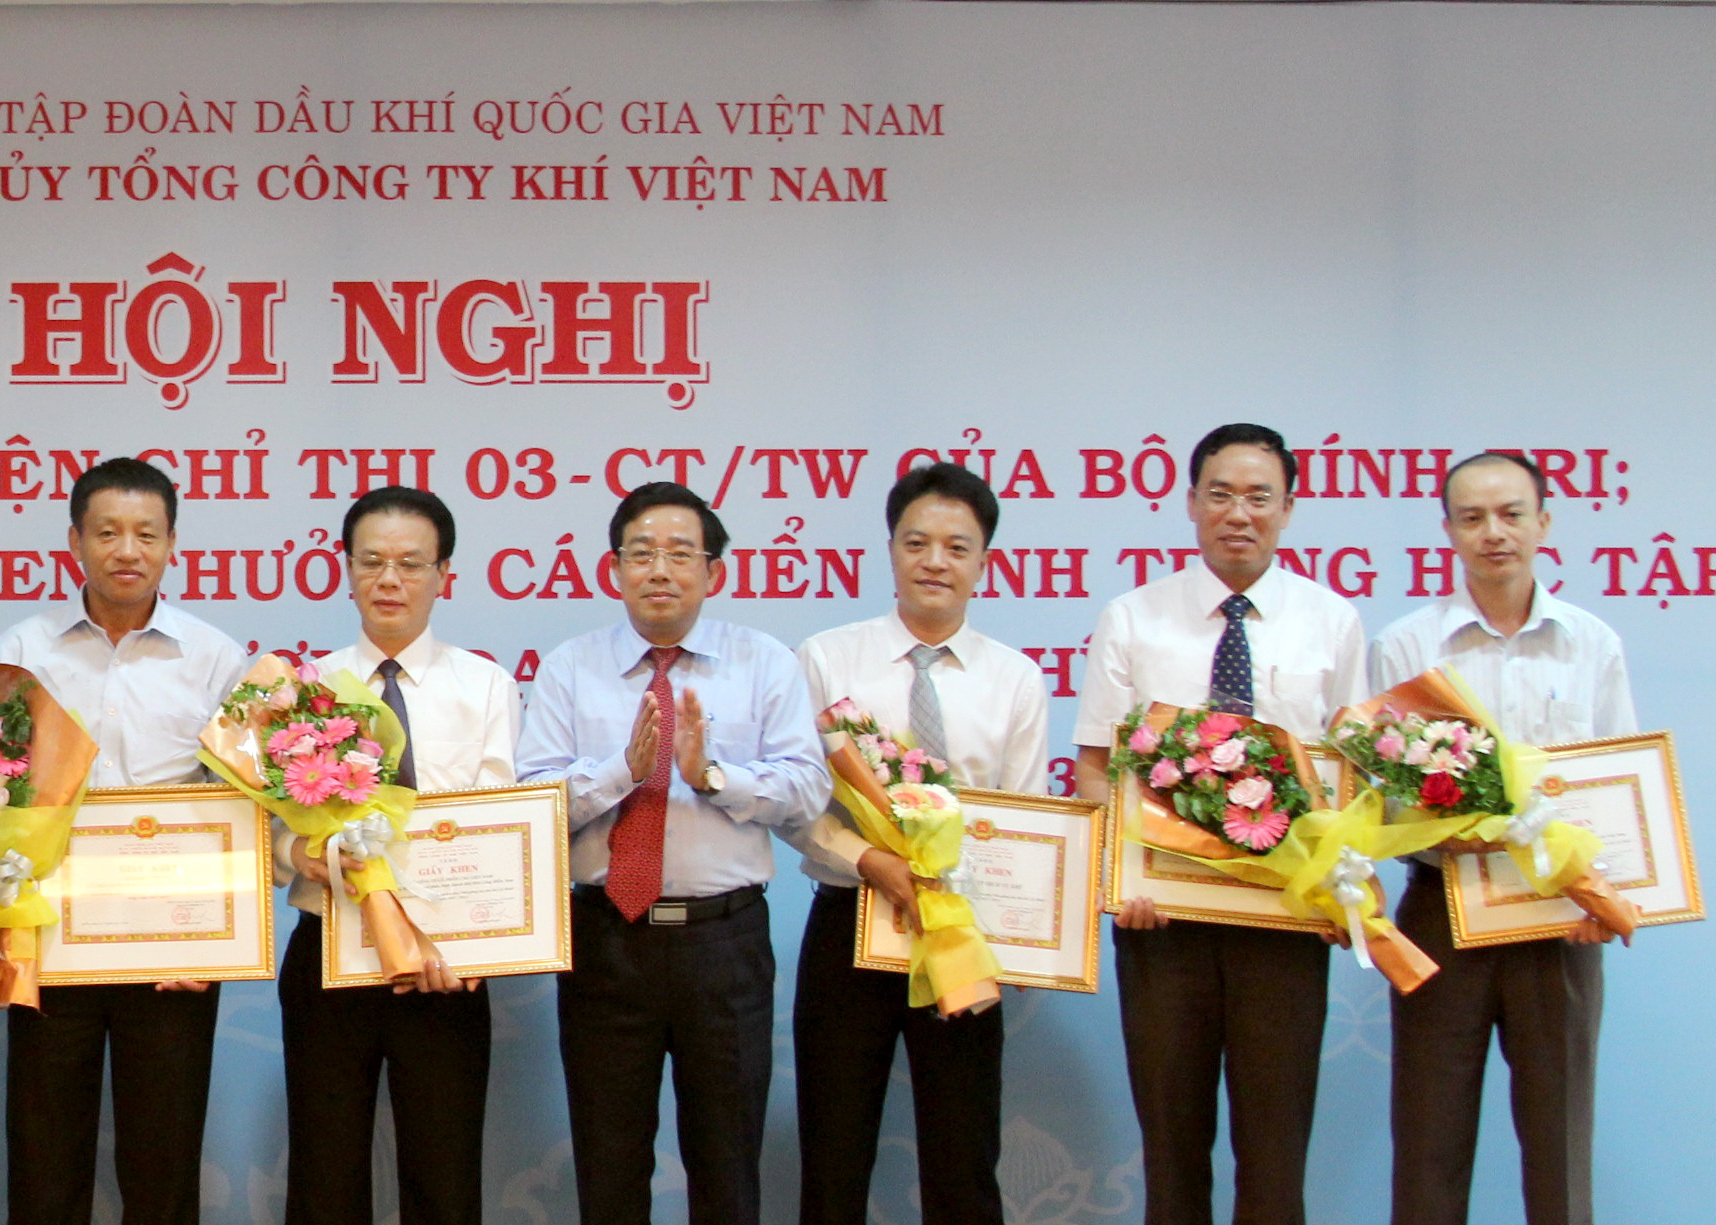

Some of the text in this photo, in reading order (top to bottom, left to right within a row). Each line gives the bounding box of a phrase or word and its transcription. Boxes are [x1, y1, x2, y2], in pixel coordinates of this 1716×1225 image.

[104, 91, 237, 135] ĐOÀN
[255, 85, 355, 134] DẦU
[371, 91, 456, 134] KHÍ
[472, 87, 604, 141] QUỐC
[620, 100, 702, 135] GIA
[716, 94, 825, 143] VIỆT
[841, 103, 945, 136] NAM
[88, 147, 240, 201] TỔNG
[257, 154, 410, 201] CÔNG
[426, 165, 494, 201] TY
[510, 154, 610, 201] KHÍ
[626, 155, 753, 211] VIỆT
[769, 166, 889, 202] NAM
[9, 252, 710, 410] HỘI NGHỊ
[1080, 433, 1176, 512] BỘ
[1291, 432, 1453, 499] ÍNH
[1484, 448, 1629, 512] RỊ;
